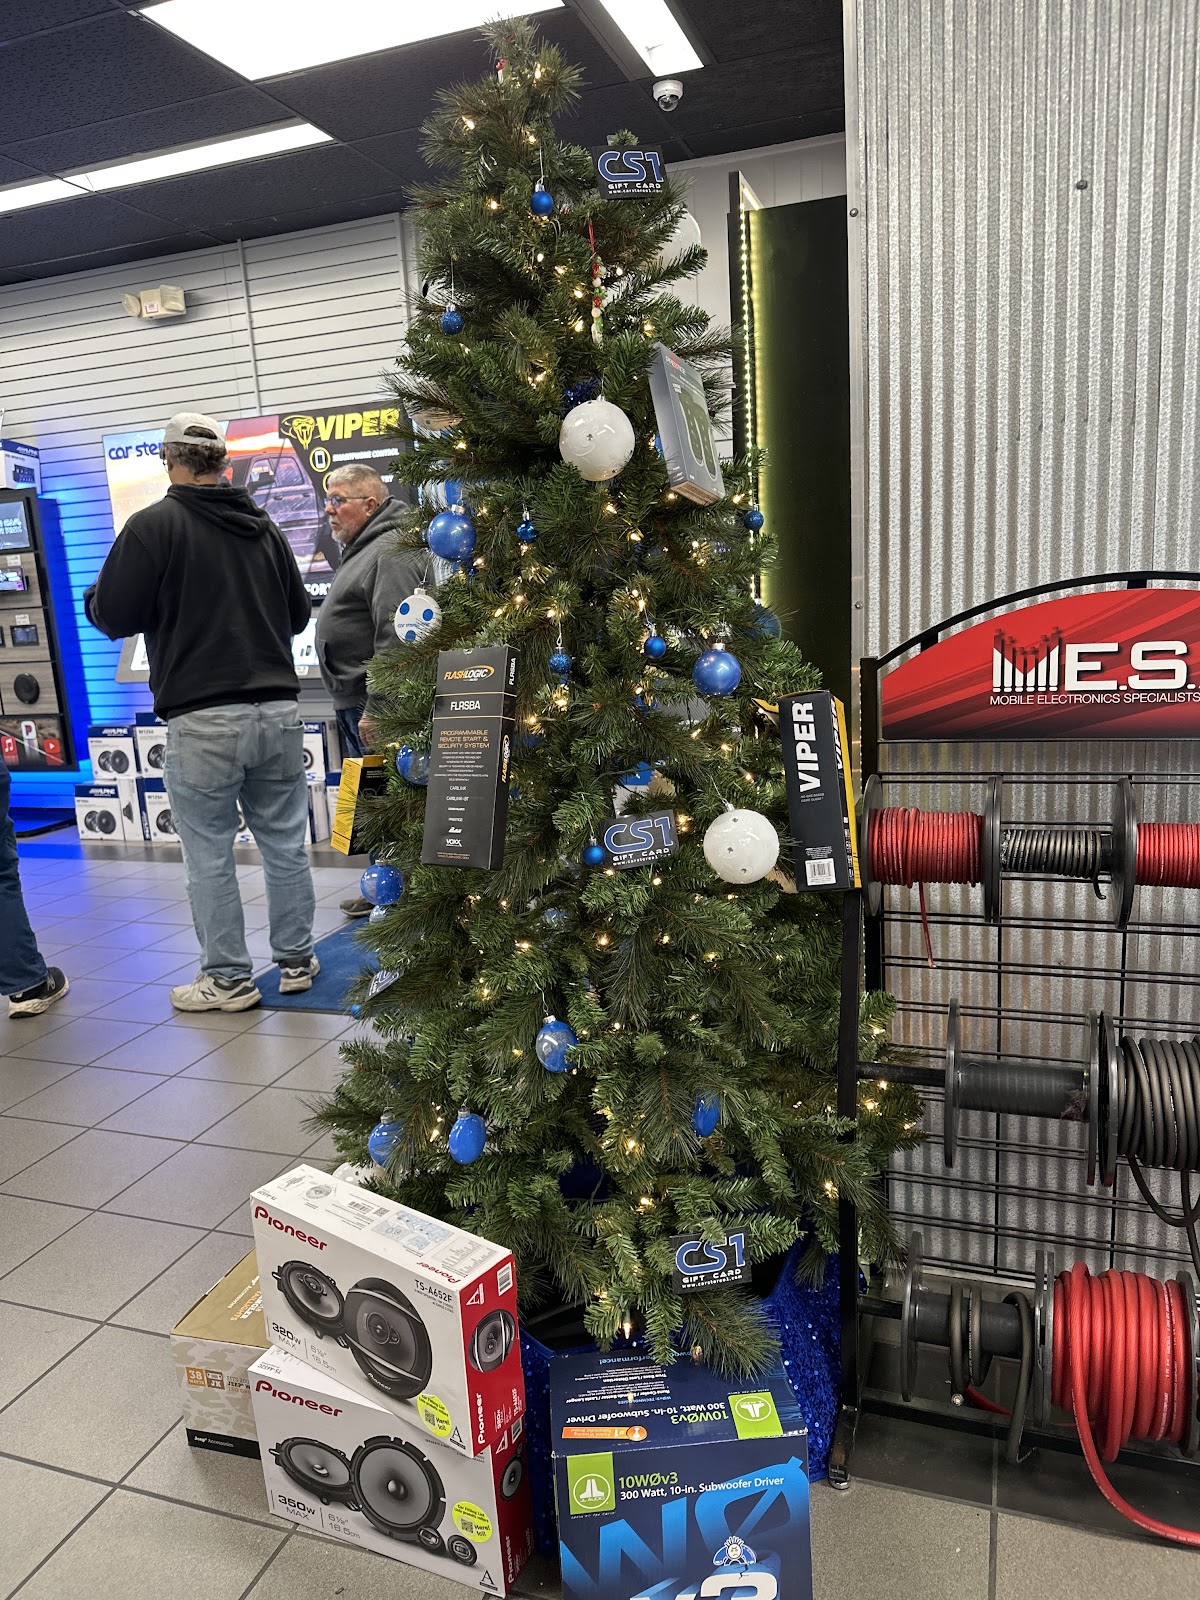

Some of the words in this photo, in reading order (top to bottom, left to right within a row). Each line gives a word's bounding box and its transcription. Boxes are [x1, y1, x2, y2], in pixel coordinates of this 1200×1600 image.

[598, 151, 664, 182] CS1
[316, 408, 400, 441] VIPER
[108, 446, 132, 460] car
[444, 668, 489, 680] FLASHLOGIC
[451, 701, 481, 711] FLRSBA
[990, 695, 1034, 705] MOBILE
[1037, 693, 1120, 704] ELECTRONICS
[791, 701, 822, 793] VIPER
[604, 816, 673, 854] CS1
[641, 848, 670, 856] CARD
[254, 1205, 328, 1251] Pioneer
[675, 1233, 746, 1275] CS1
[417, 1261, 461, 1284] Pioneer
[682, 1275, 705, 1283] GIFT
[712, 1268, 741, 1279] CARD
[415, 1279, 452, 1303] TS-A652F
[278, 1336, 297, 1350] MAX
[189, 1370, 203, 1380] 38
[210, 1380, 222, 1388] JK
[367, 1372, 392, 1391] Pioneer
[255, 1380, 343, 1417] Pioneer
[598, 1407, 649, 1420] Subwoofer
[680, 1404, 705, 1412] Watt,
[477, 1393, 486, 1444] Pioneer
[566, 1412, 596, 1424] Driver
[618, 1471, 679, 1489] 10WØv3
[620, 1490, 639, 1500] 300
[640, 1487, 668, 1499] Watt,
[670, 1484, 697, 1496] 10-in.
[699, 1479, 752, 1493] Subwoofer
[753, 1476, 784, 1487] Driver
[286, 1507, 310, 1521] MAX
[508, 1535, 516, 1584] Pioneer
